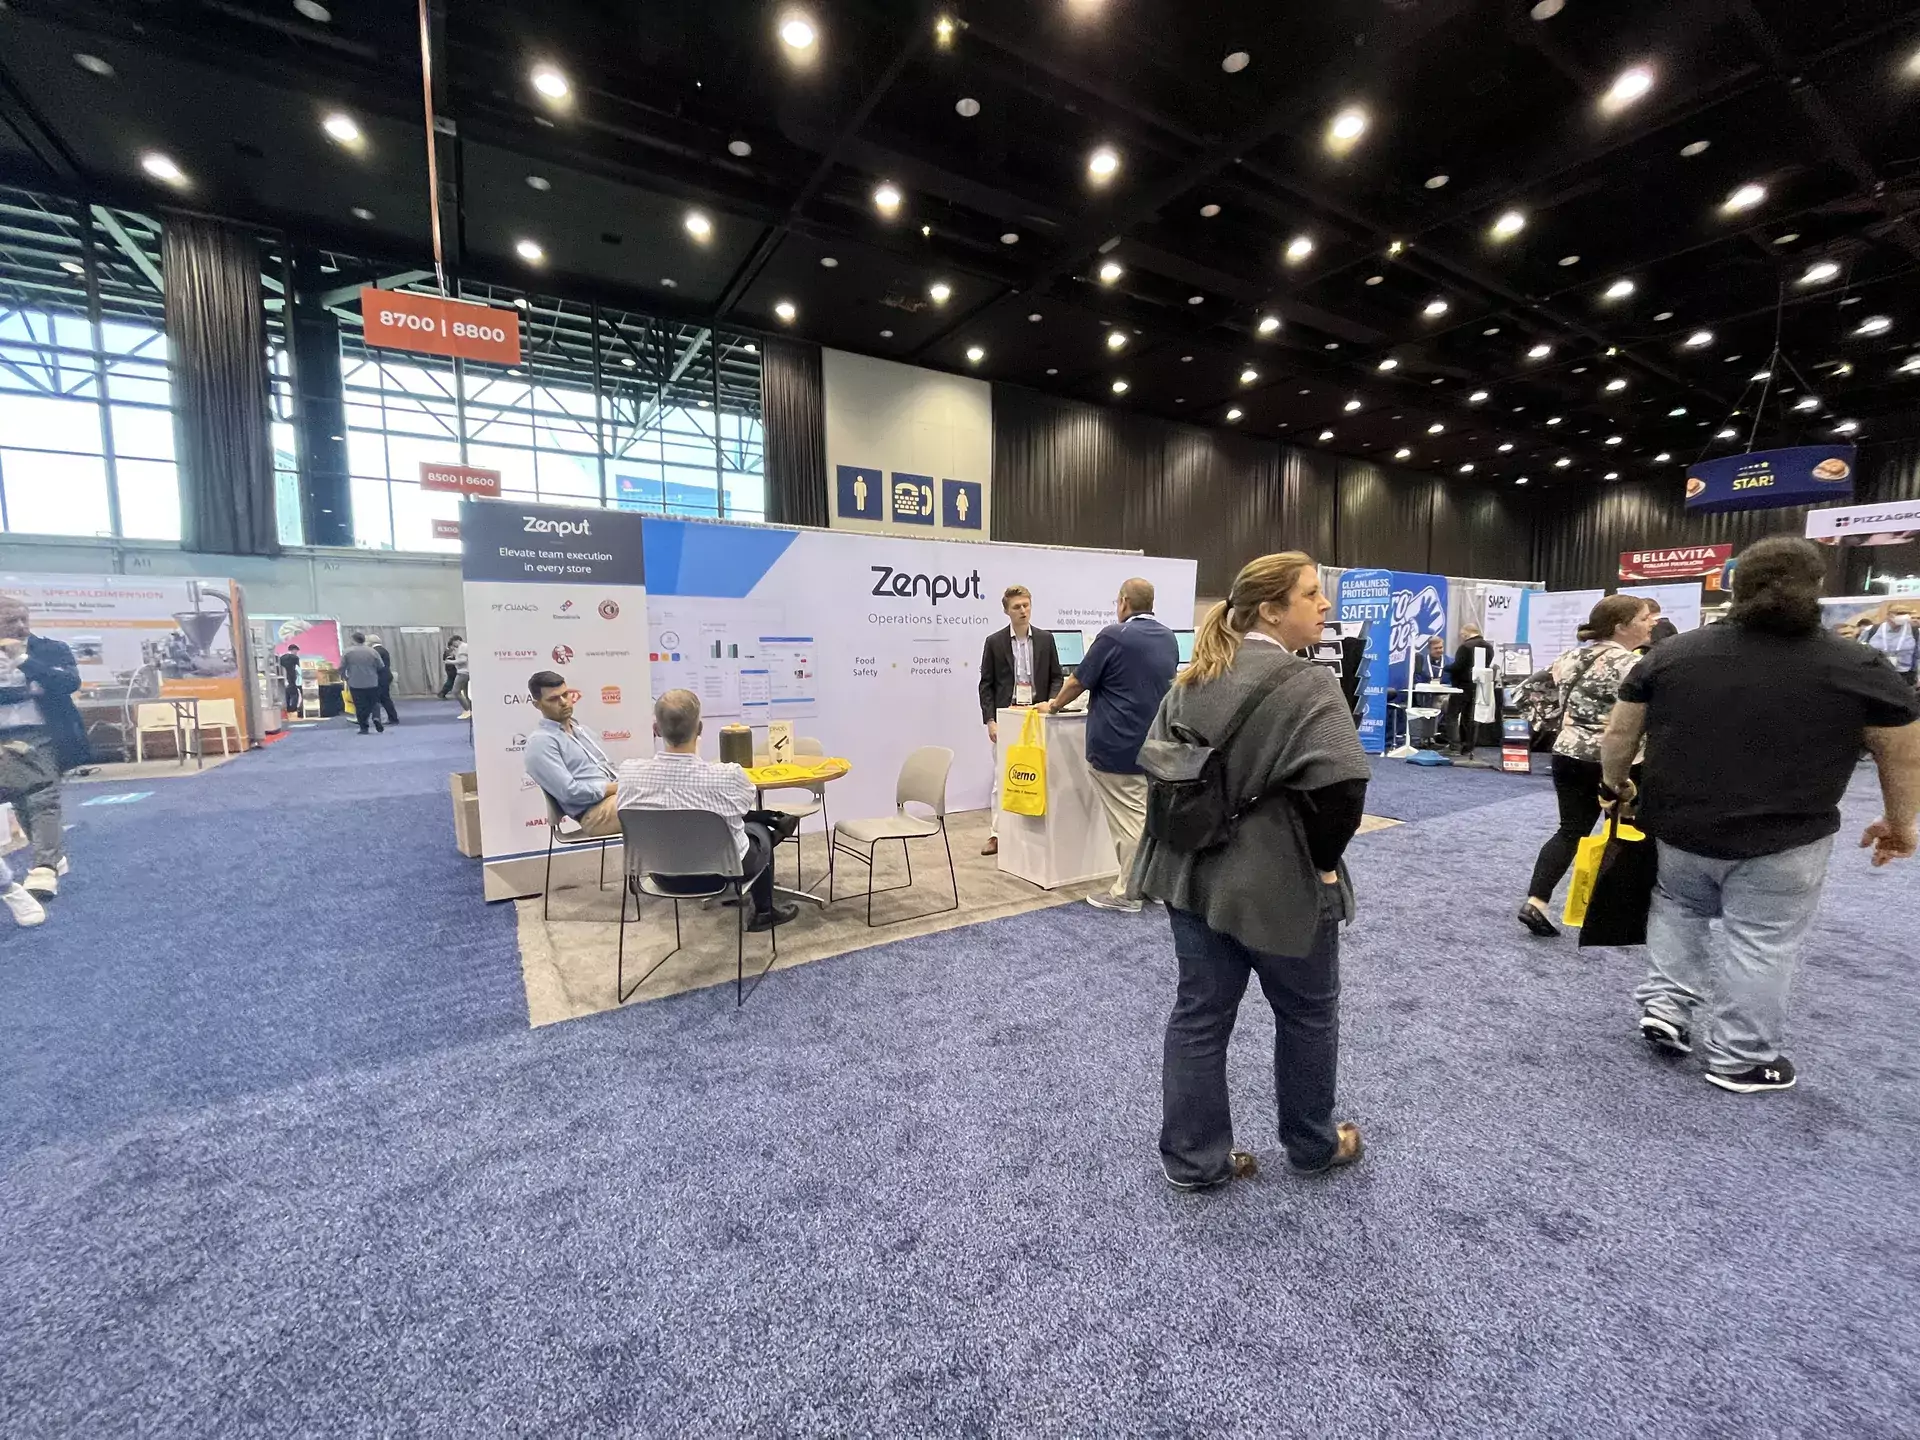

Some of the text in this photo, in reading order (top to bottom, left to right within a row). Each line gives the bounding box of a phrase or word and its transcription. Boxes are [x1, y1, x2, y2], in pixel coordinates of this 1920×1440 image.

[380, 310, 435, 332] 8700
[452, 322, 505, 343] 8800
[428, 472, 457, 483] 8500
[466, 476, 495, 486] 8600
[1732, 475, 1774, 491] STAR!
[499, 547, 613, 561] Elevate team execution
[1633, 548, 1716, 563] BELLAVITA
[524, 563, 592, 574] in every store
[1074, 608, 1081, 617] by
[1082, 609, 1102, 617] leading
[1341, 604, 1389, 619] SAFETY
[868, 613, 989, 626] Operations Execution
[855, 656, 875, 664] Food
[912, 656, 950, 665] Operating
[853, 668, 878, 677] Safety
[911, 667, 952, 675] Procedures
[1011, 767, 1036, 781] Sterno
[526, 819, 544, 827] PAPA
